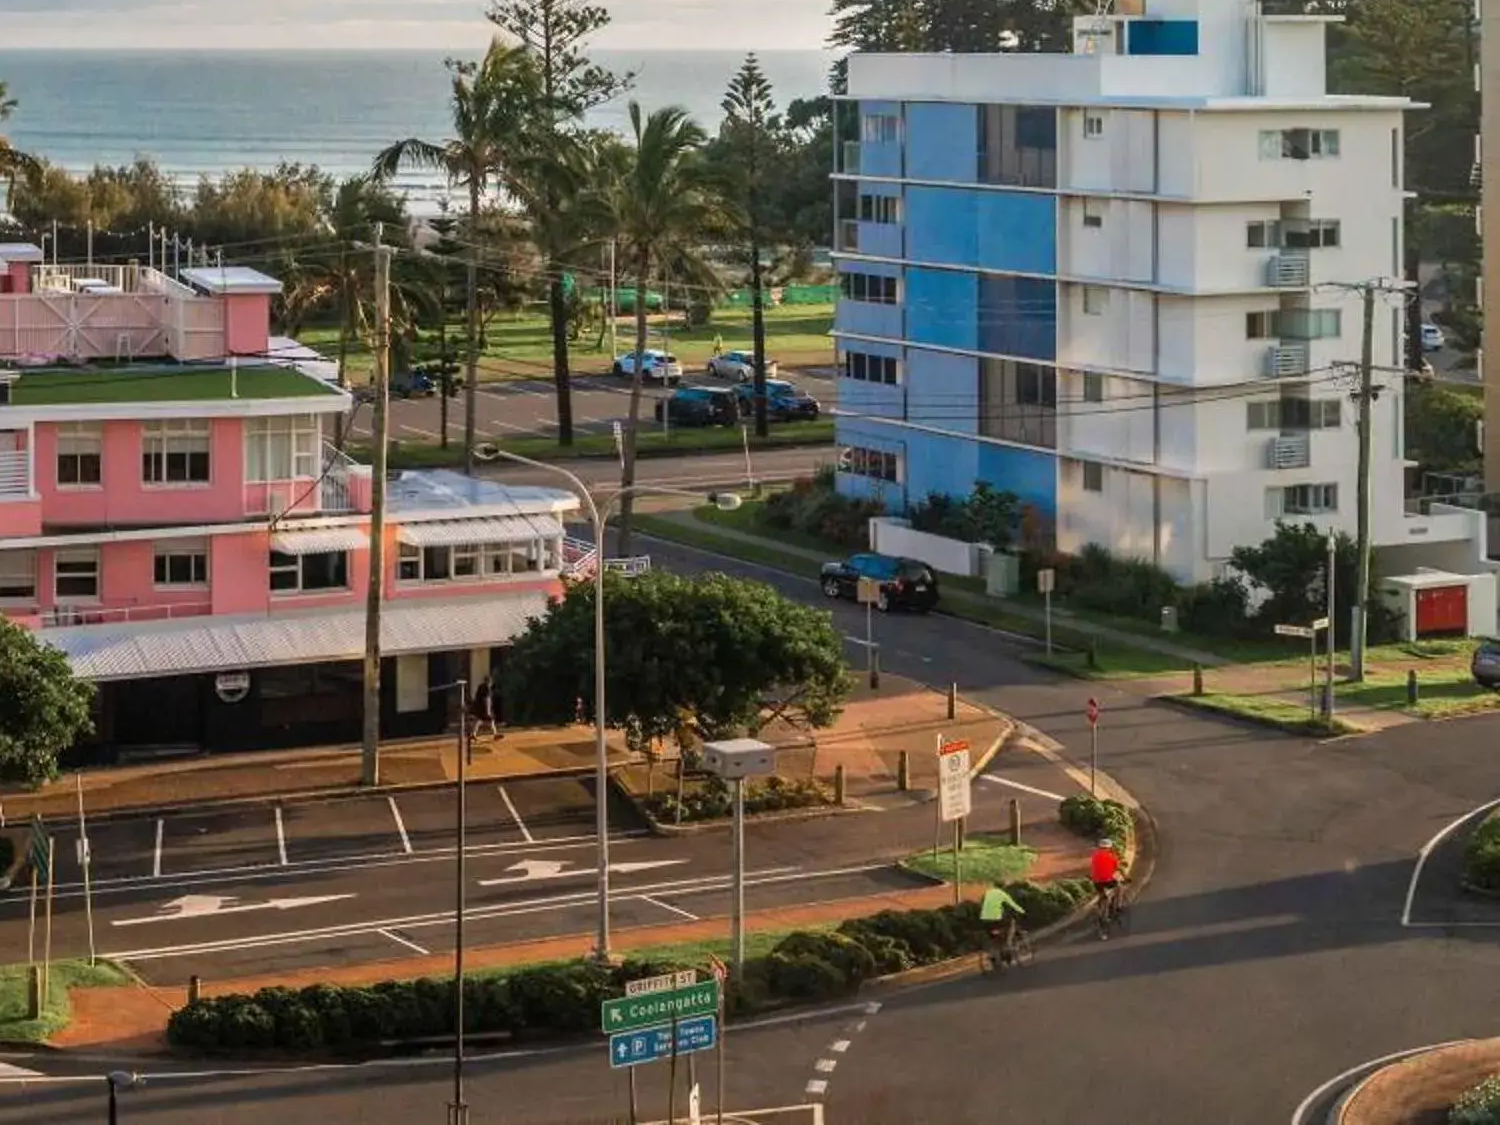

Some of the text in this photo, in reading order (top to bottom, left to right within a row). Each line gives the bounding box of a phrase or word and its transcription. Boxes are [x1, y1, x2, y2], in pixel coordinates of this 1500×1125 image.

[629, 972, 693, 993] GRIFFIT ST
[630, 991, 711, 1017] Coolangatta
